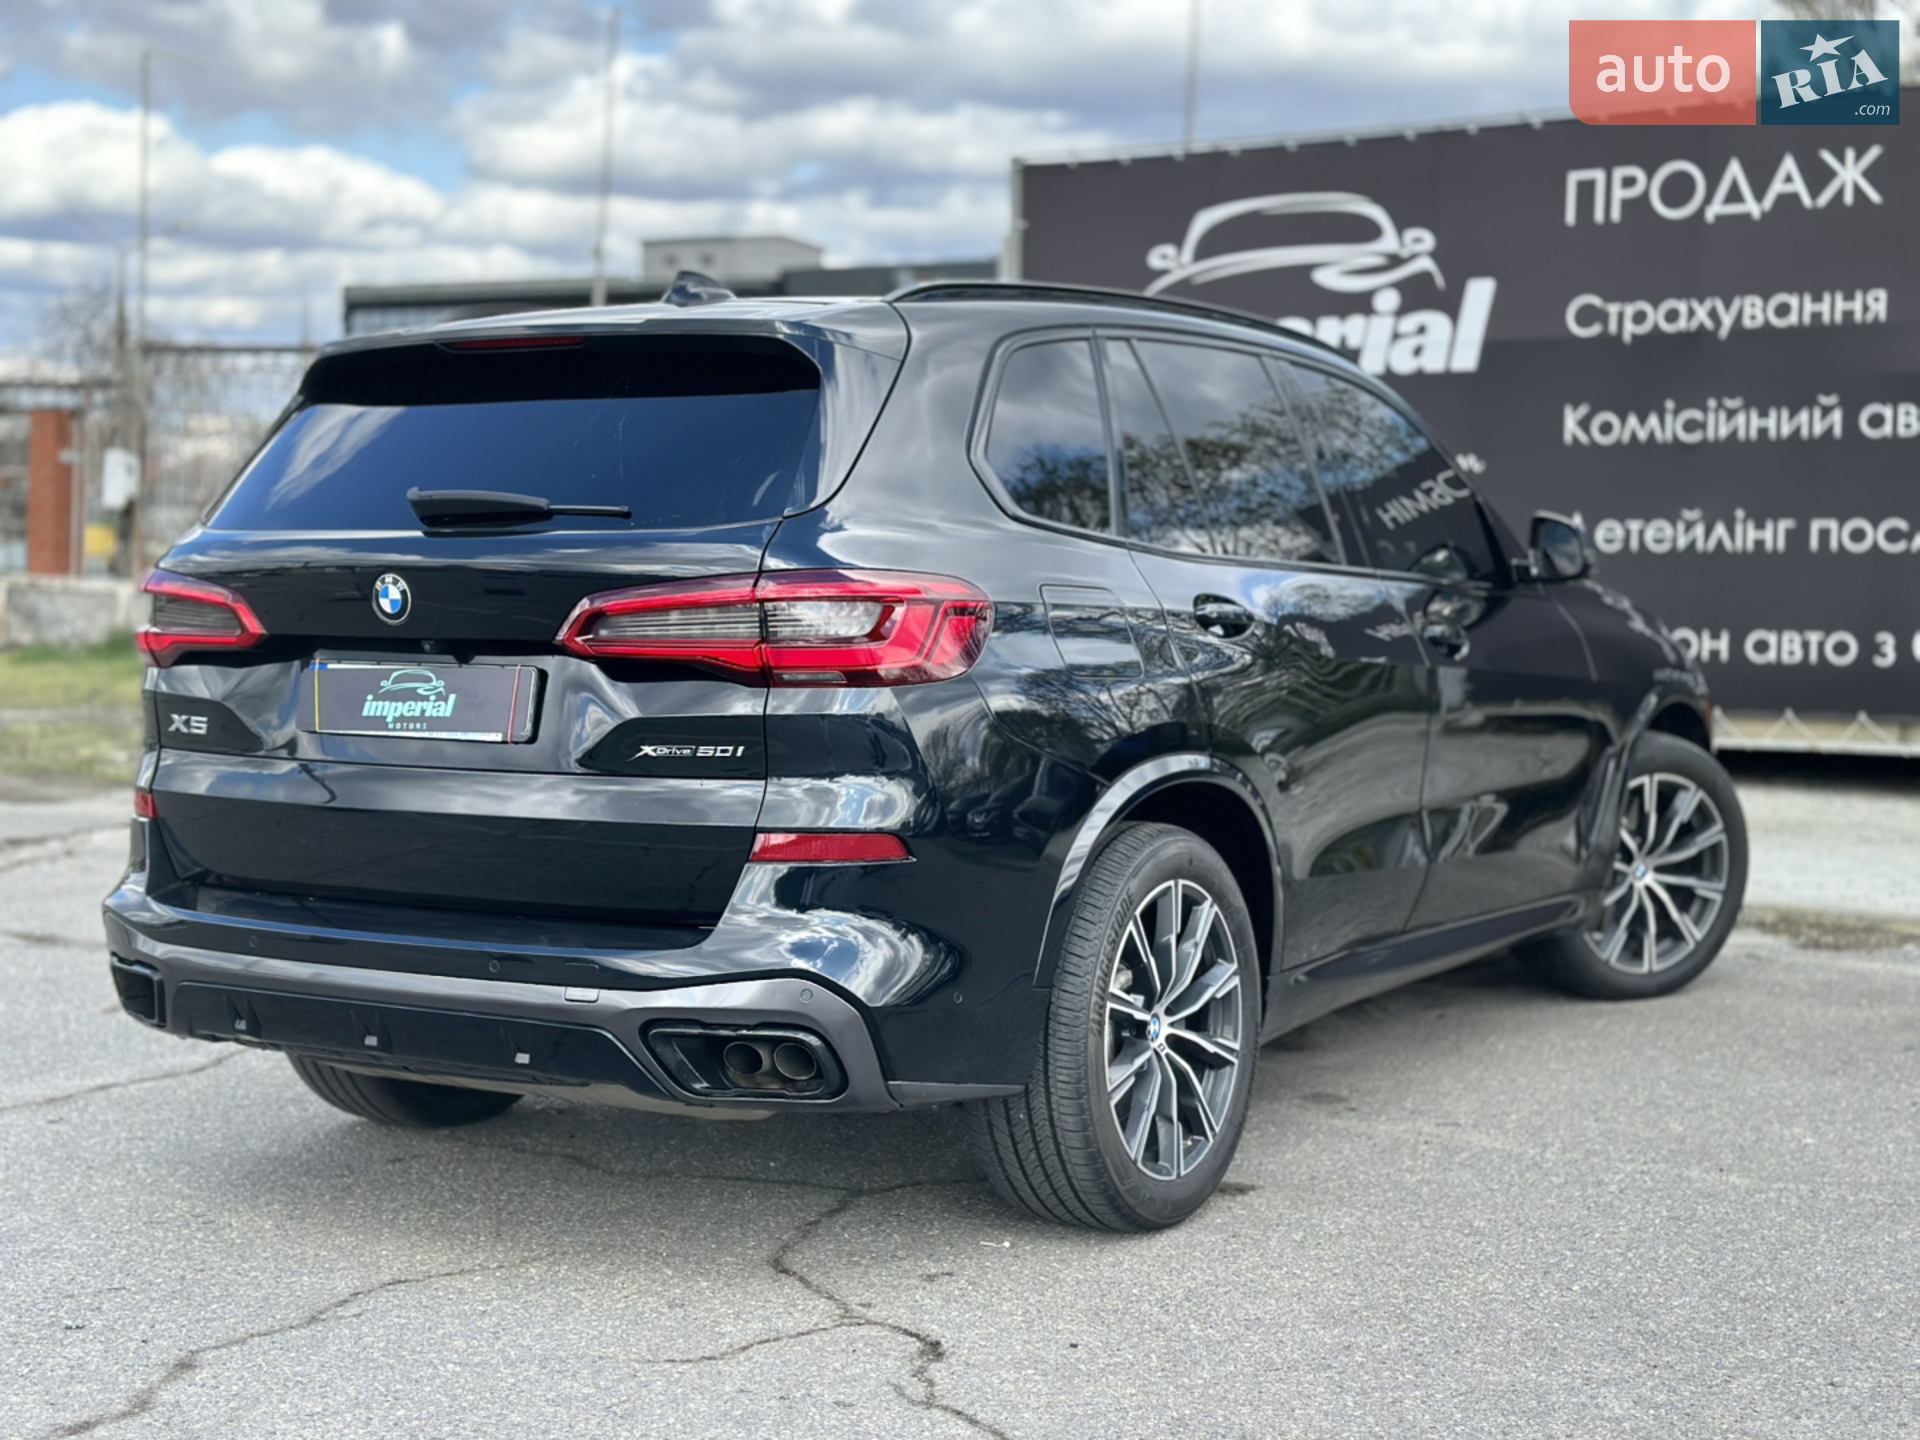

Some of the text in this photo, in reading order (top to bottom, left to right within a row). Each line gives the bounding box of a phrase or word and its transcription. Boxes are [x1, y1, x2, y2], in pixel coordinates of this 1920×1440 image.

[1564, 144, 1883, 228] ПРОДАЖ
[1275, 275, 1497, 376] rial
[1565, 288, 1888, 345] Страхування
[1563, 393, 1844, 447] Комісійний
[1574, 507, 1797, 563] етейлінг
[1744, 629, 1859, 668] авто
[168, 713, 208, 735] X5
[362, 693, 457, 723] imperial
[387, 722, 428, 730] MOTORS
[1089, 886, 1135, 1040] BRIDGESTONE
